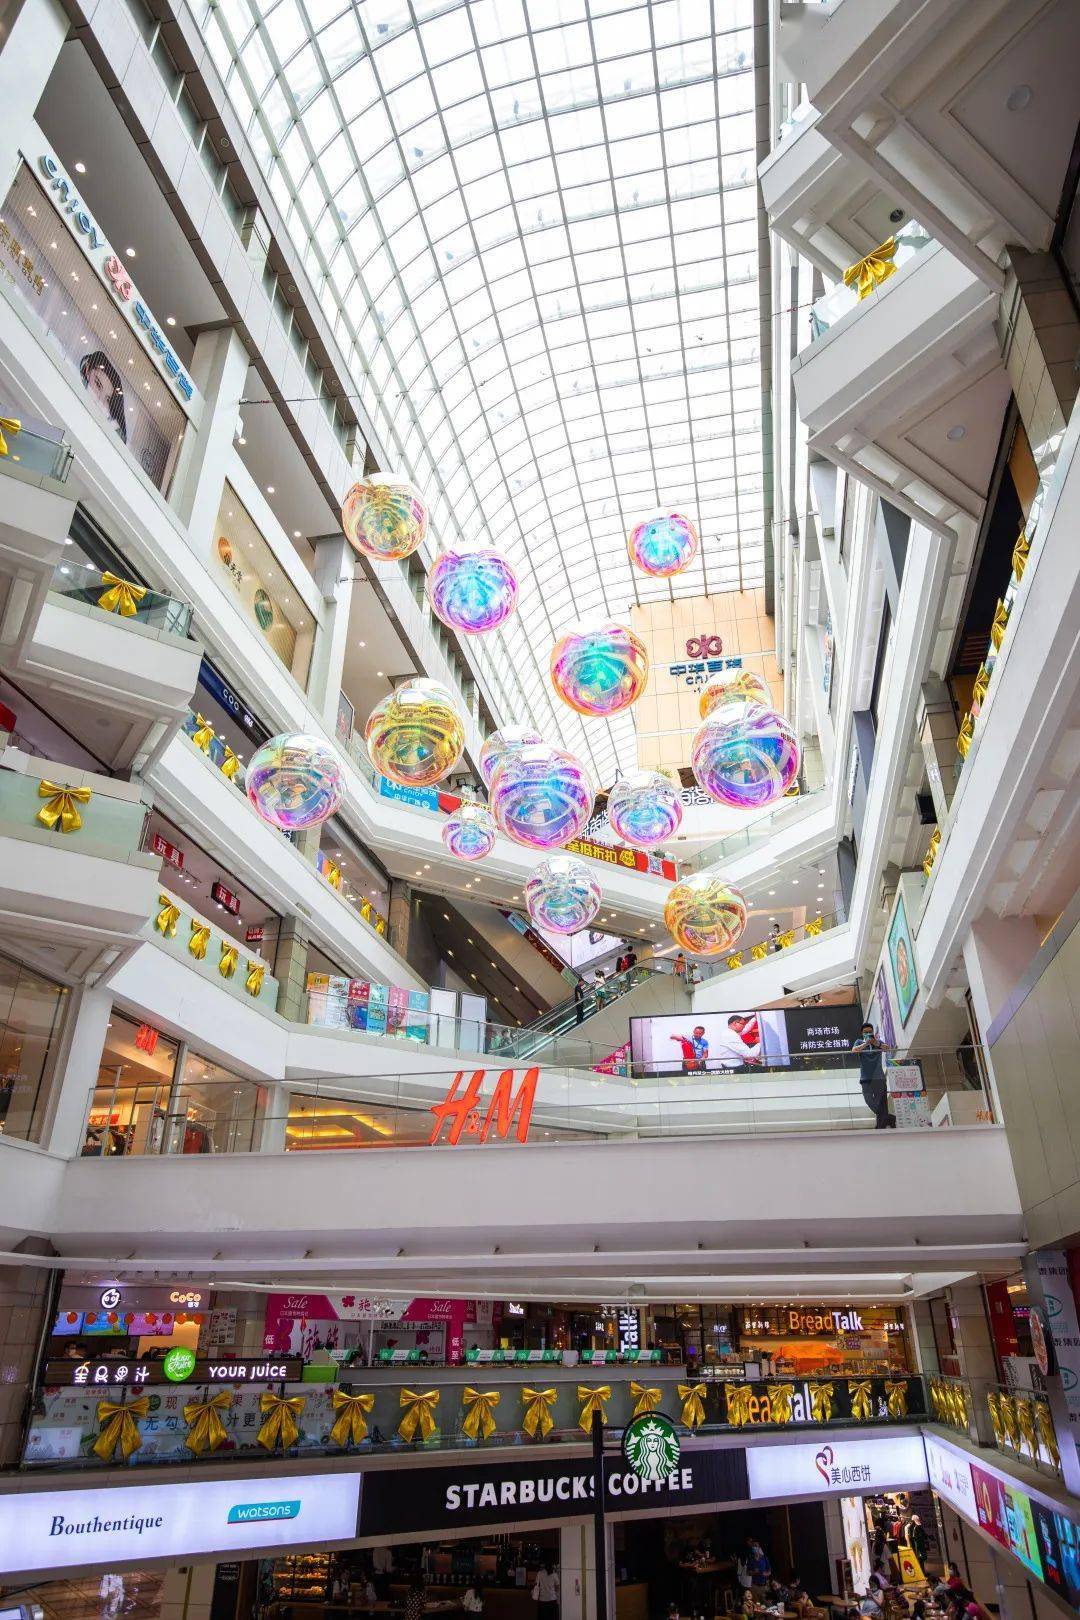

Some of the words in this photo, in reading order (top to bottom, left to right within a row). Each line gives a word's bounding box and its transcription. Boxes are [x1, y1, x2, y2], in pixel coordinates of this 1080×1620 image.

[806, 1026, 840, 1036] 商场市场
[800, 1039, 850, 1050] 消防安全指南
[428, 1066, 540, 1146] H&M
[283, 1295, 308, 1309] Sale
[430, 1300, 452, 1313] Sale
[789, 1310, 864, 1331] BreadTalk
[209, 1365, 247, 1379] YOUR
[250, 1362, 287, 1380] JUICE
[831, 1464, 871, 1485] 美心西饼
[445, 1474, 595, 1510] STARBUCKS
[608, 1467, 694, 1496] COFFEE
[237, 1504, 291, 1519] watsons
[49, 1514, 163, 1537] Bouthentique
